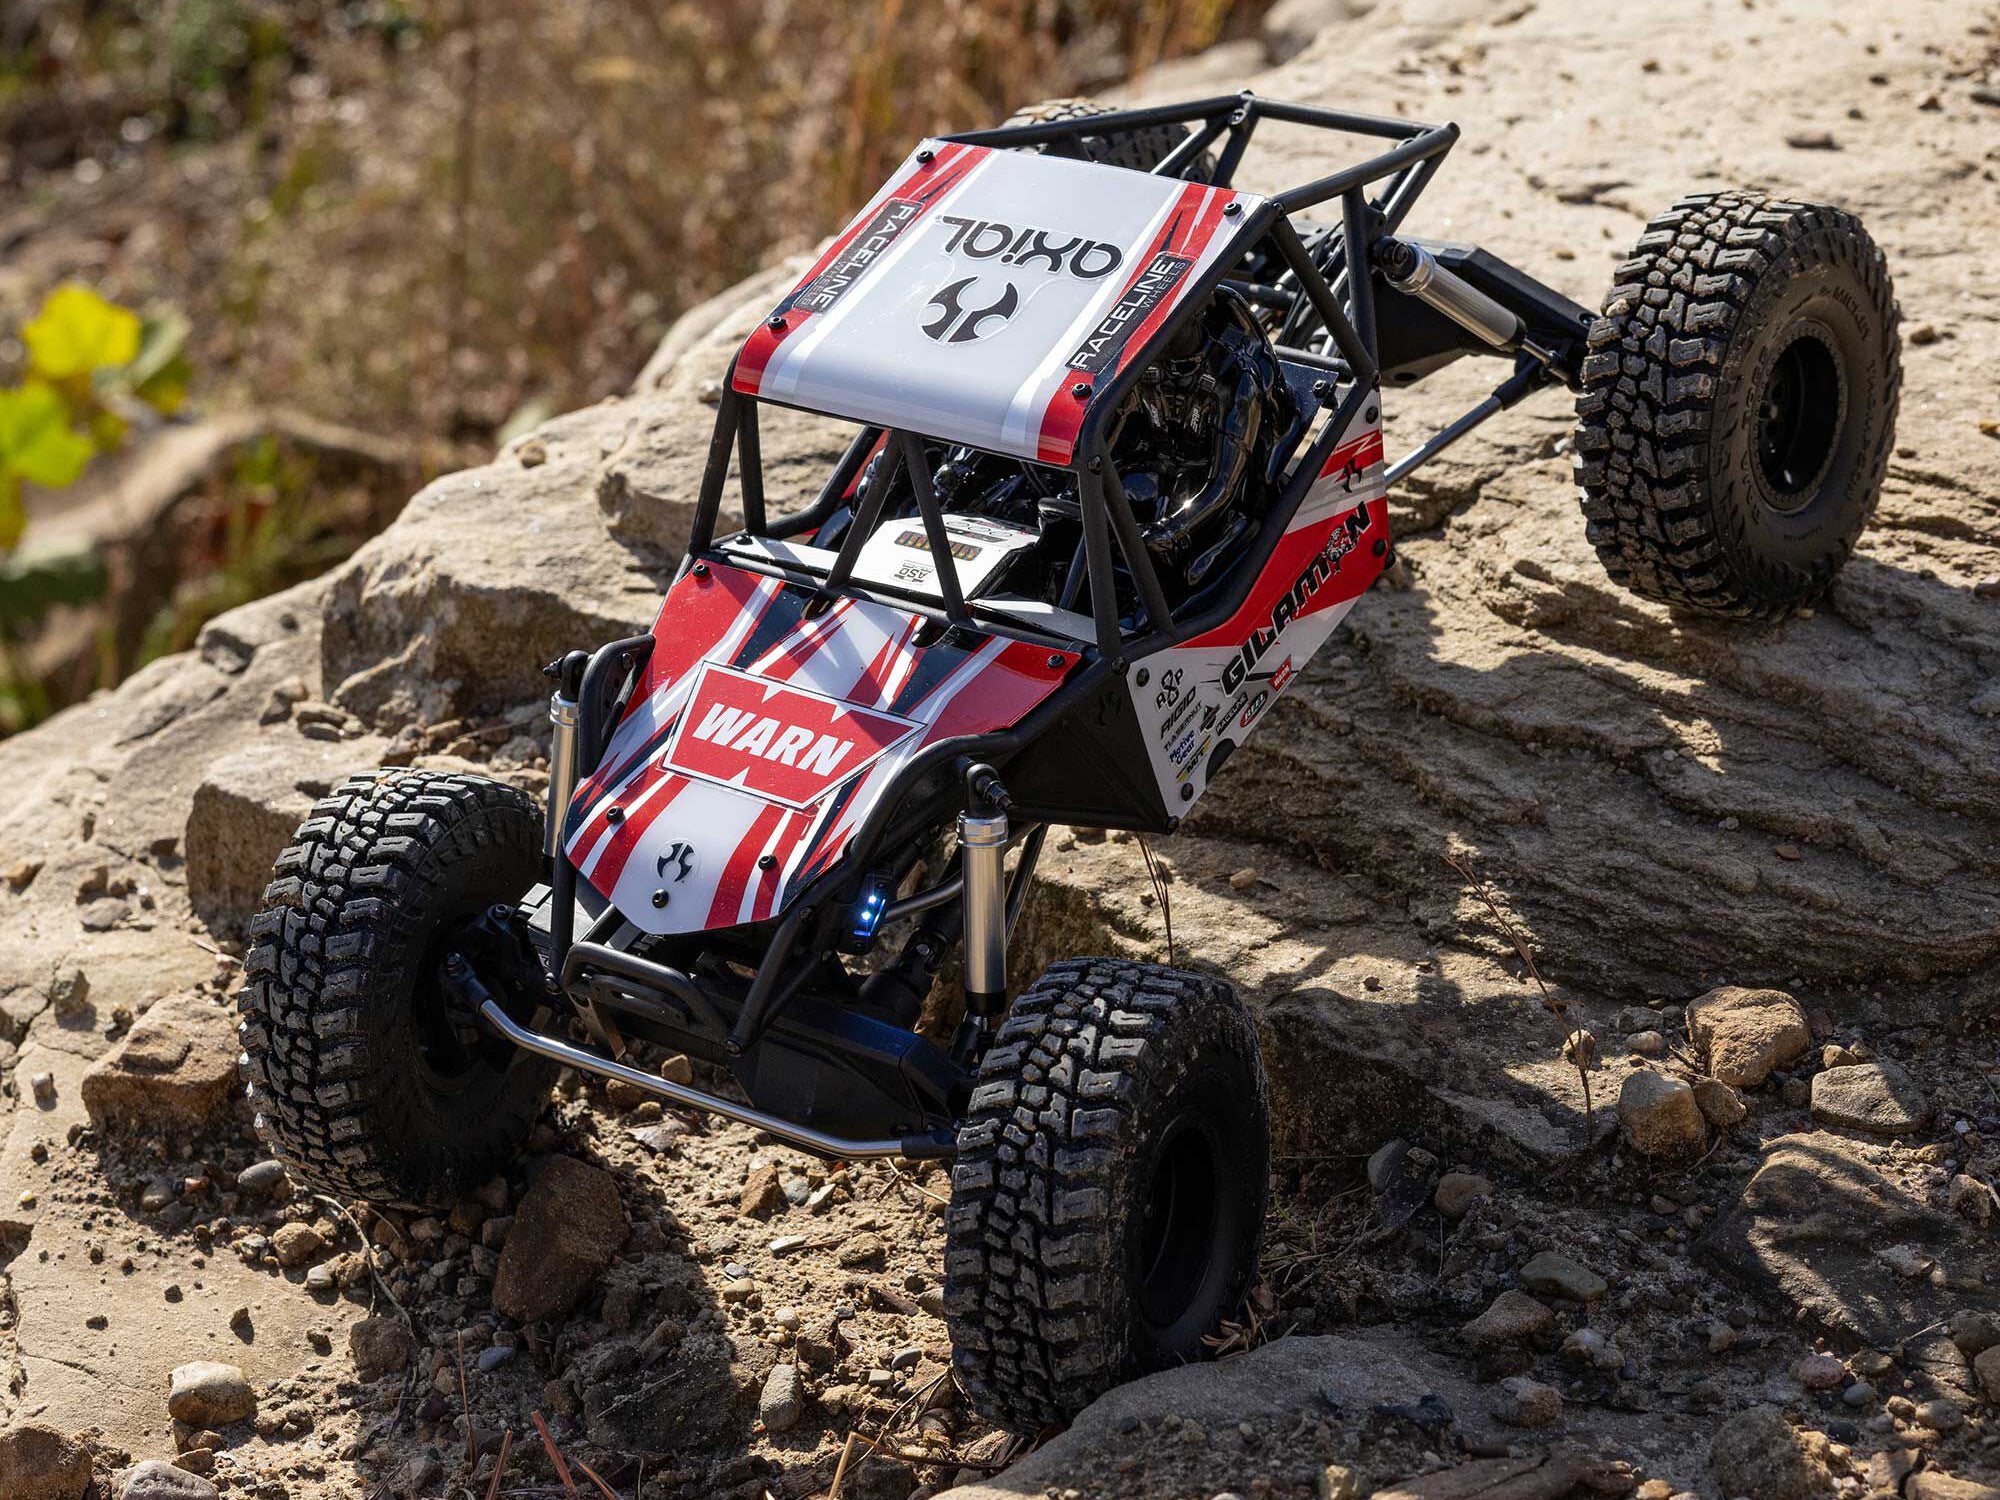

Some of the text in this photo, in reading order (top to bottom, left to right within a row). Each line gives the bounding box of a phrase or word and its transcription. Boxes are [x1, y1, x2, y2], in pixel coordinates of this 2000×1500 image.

[809, 204, 916, 309] RACELINE
[1140, 260, 1186, 309] WHEELS
[1070, 258, 1176, 370] RACELINE
[1273, 664, 1291, 687] WARN
[1160, 685, 1197, 740] RIGID
[692, 704, 855, 778] WARN
[1169, 729, 1195, 763] Motive
[1176, 740, 1196, 766] Gear
